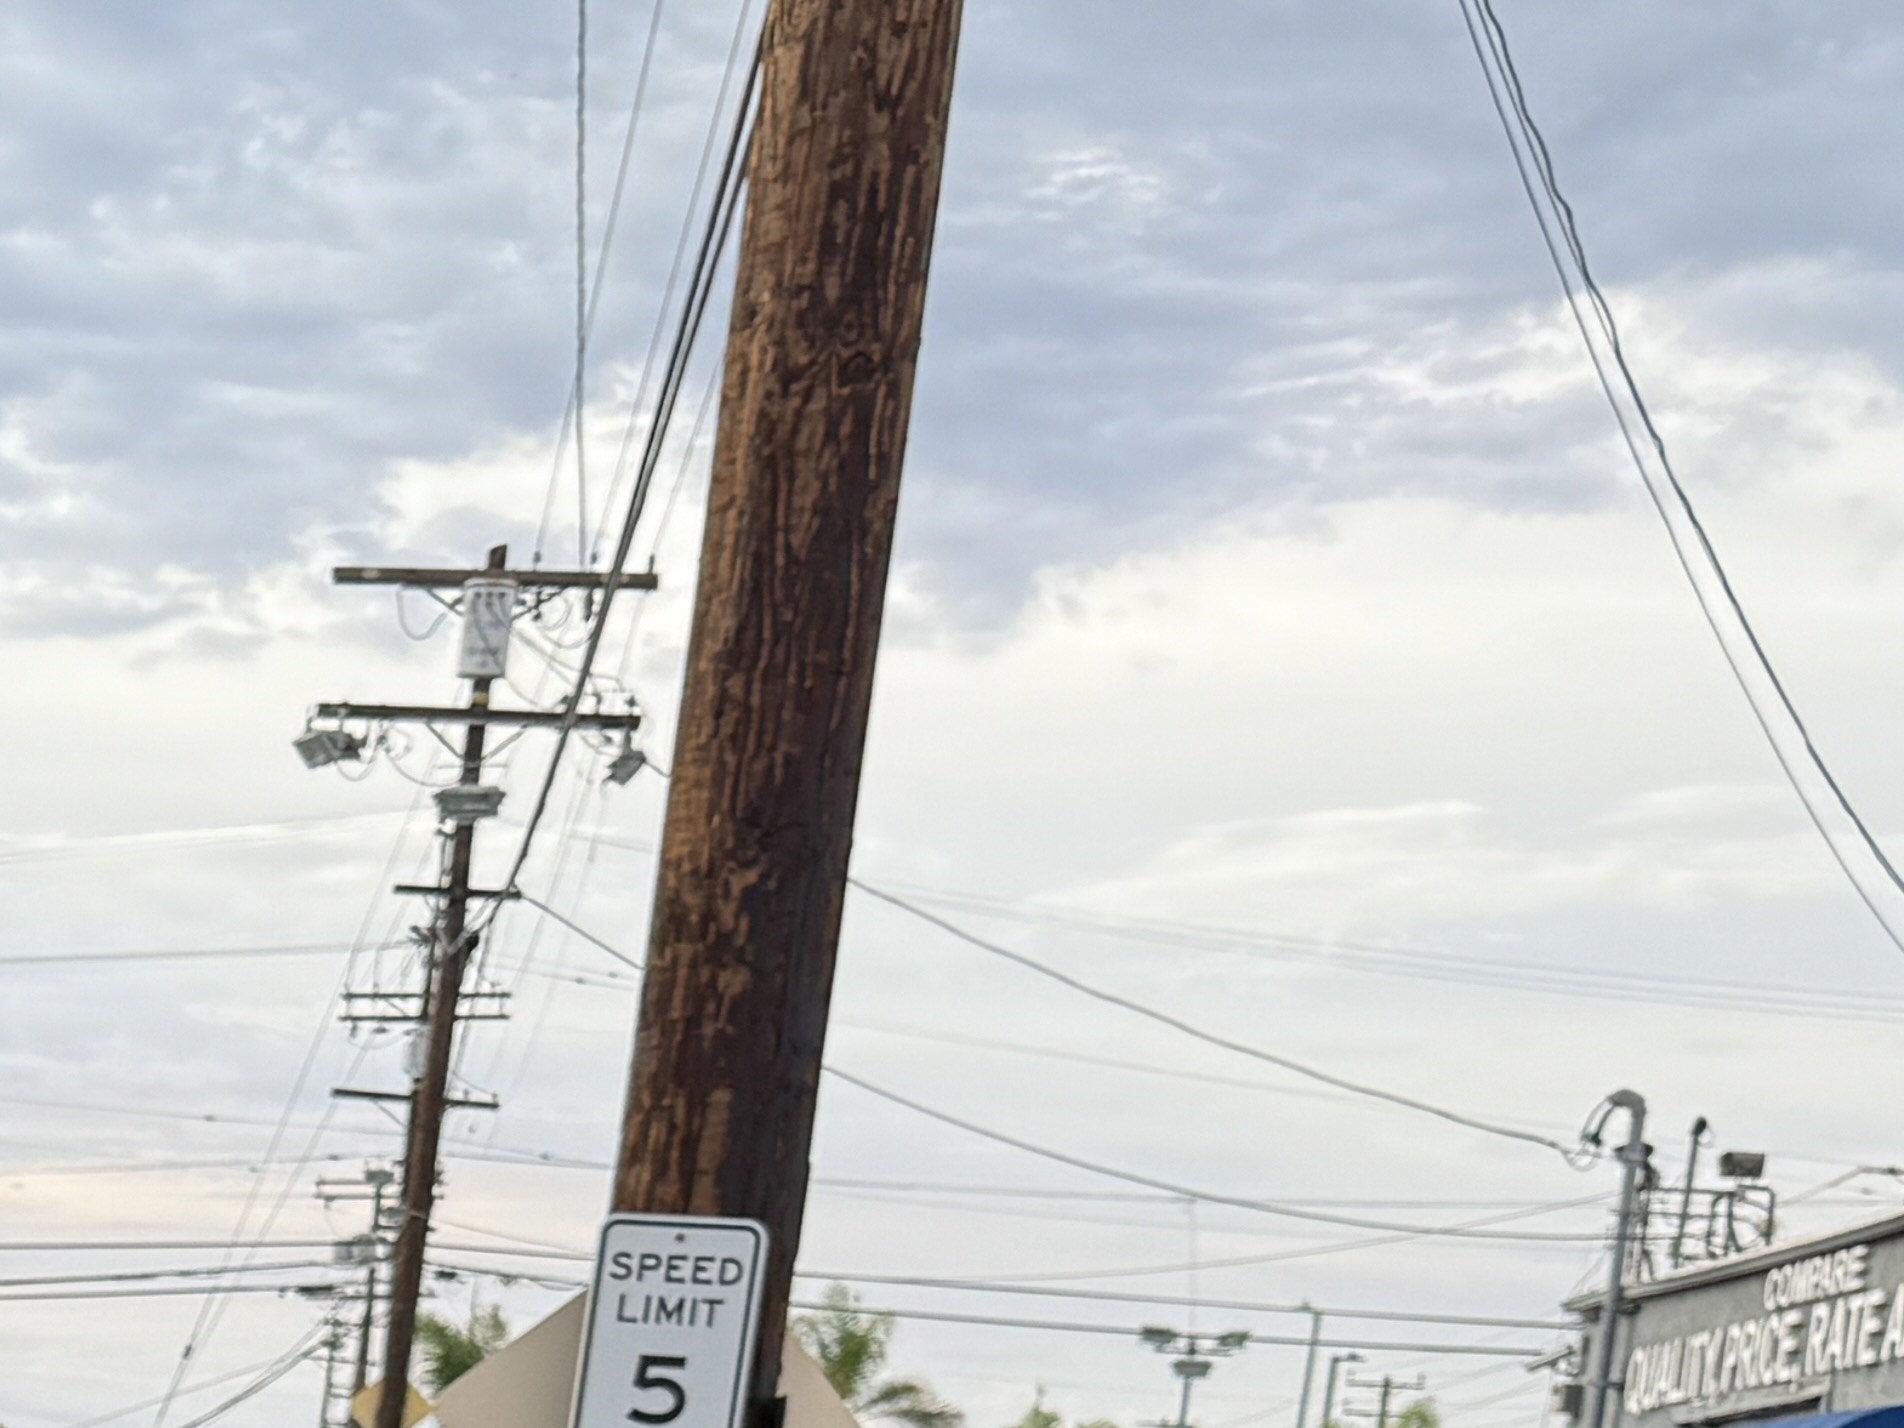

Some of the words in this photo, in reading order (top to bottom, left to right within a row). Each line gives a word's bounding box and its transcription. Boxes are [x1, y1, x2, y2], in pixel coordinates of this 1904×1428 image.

[609, 1251, 744, 1286] SPEED
[1764, 1245, 1869, 1310] COMPARE
[616, 1292, 725, 1328] LIMIT
[1805, 1288, 1887, 1376] RATE
[626, 1354, 688, 1426] 5
